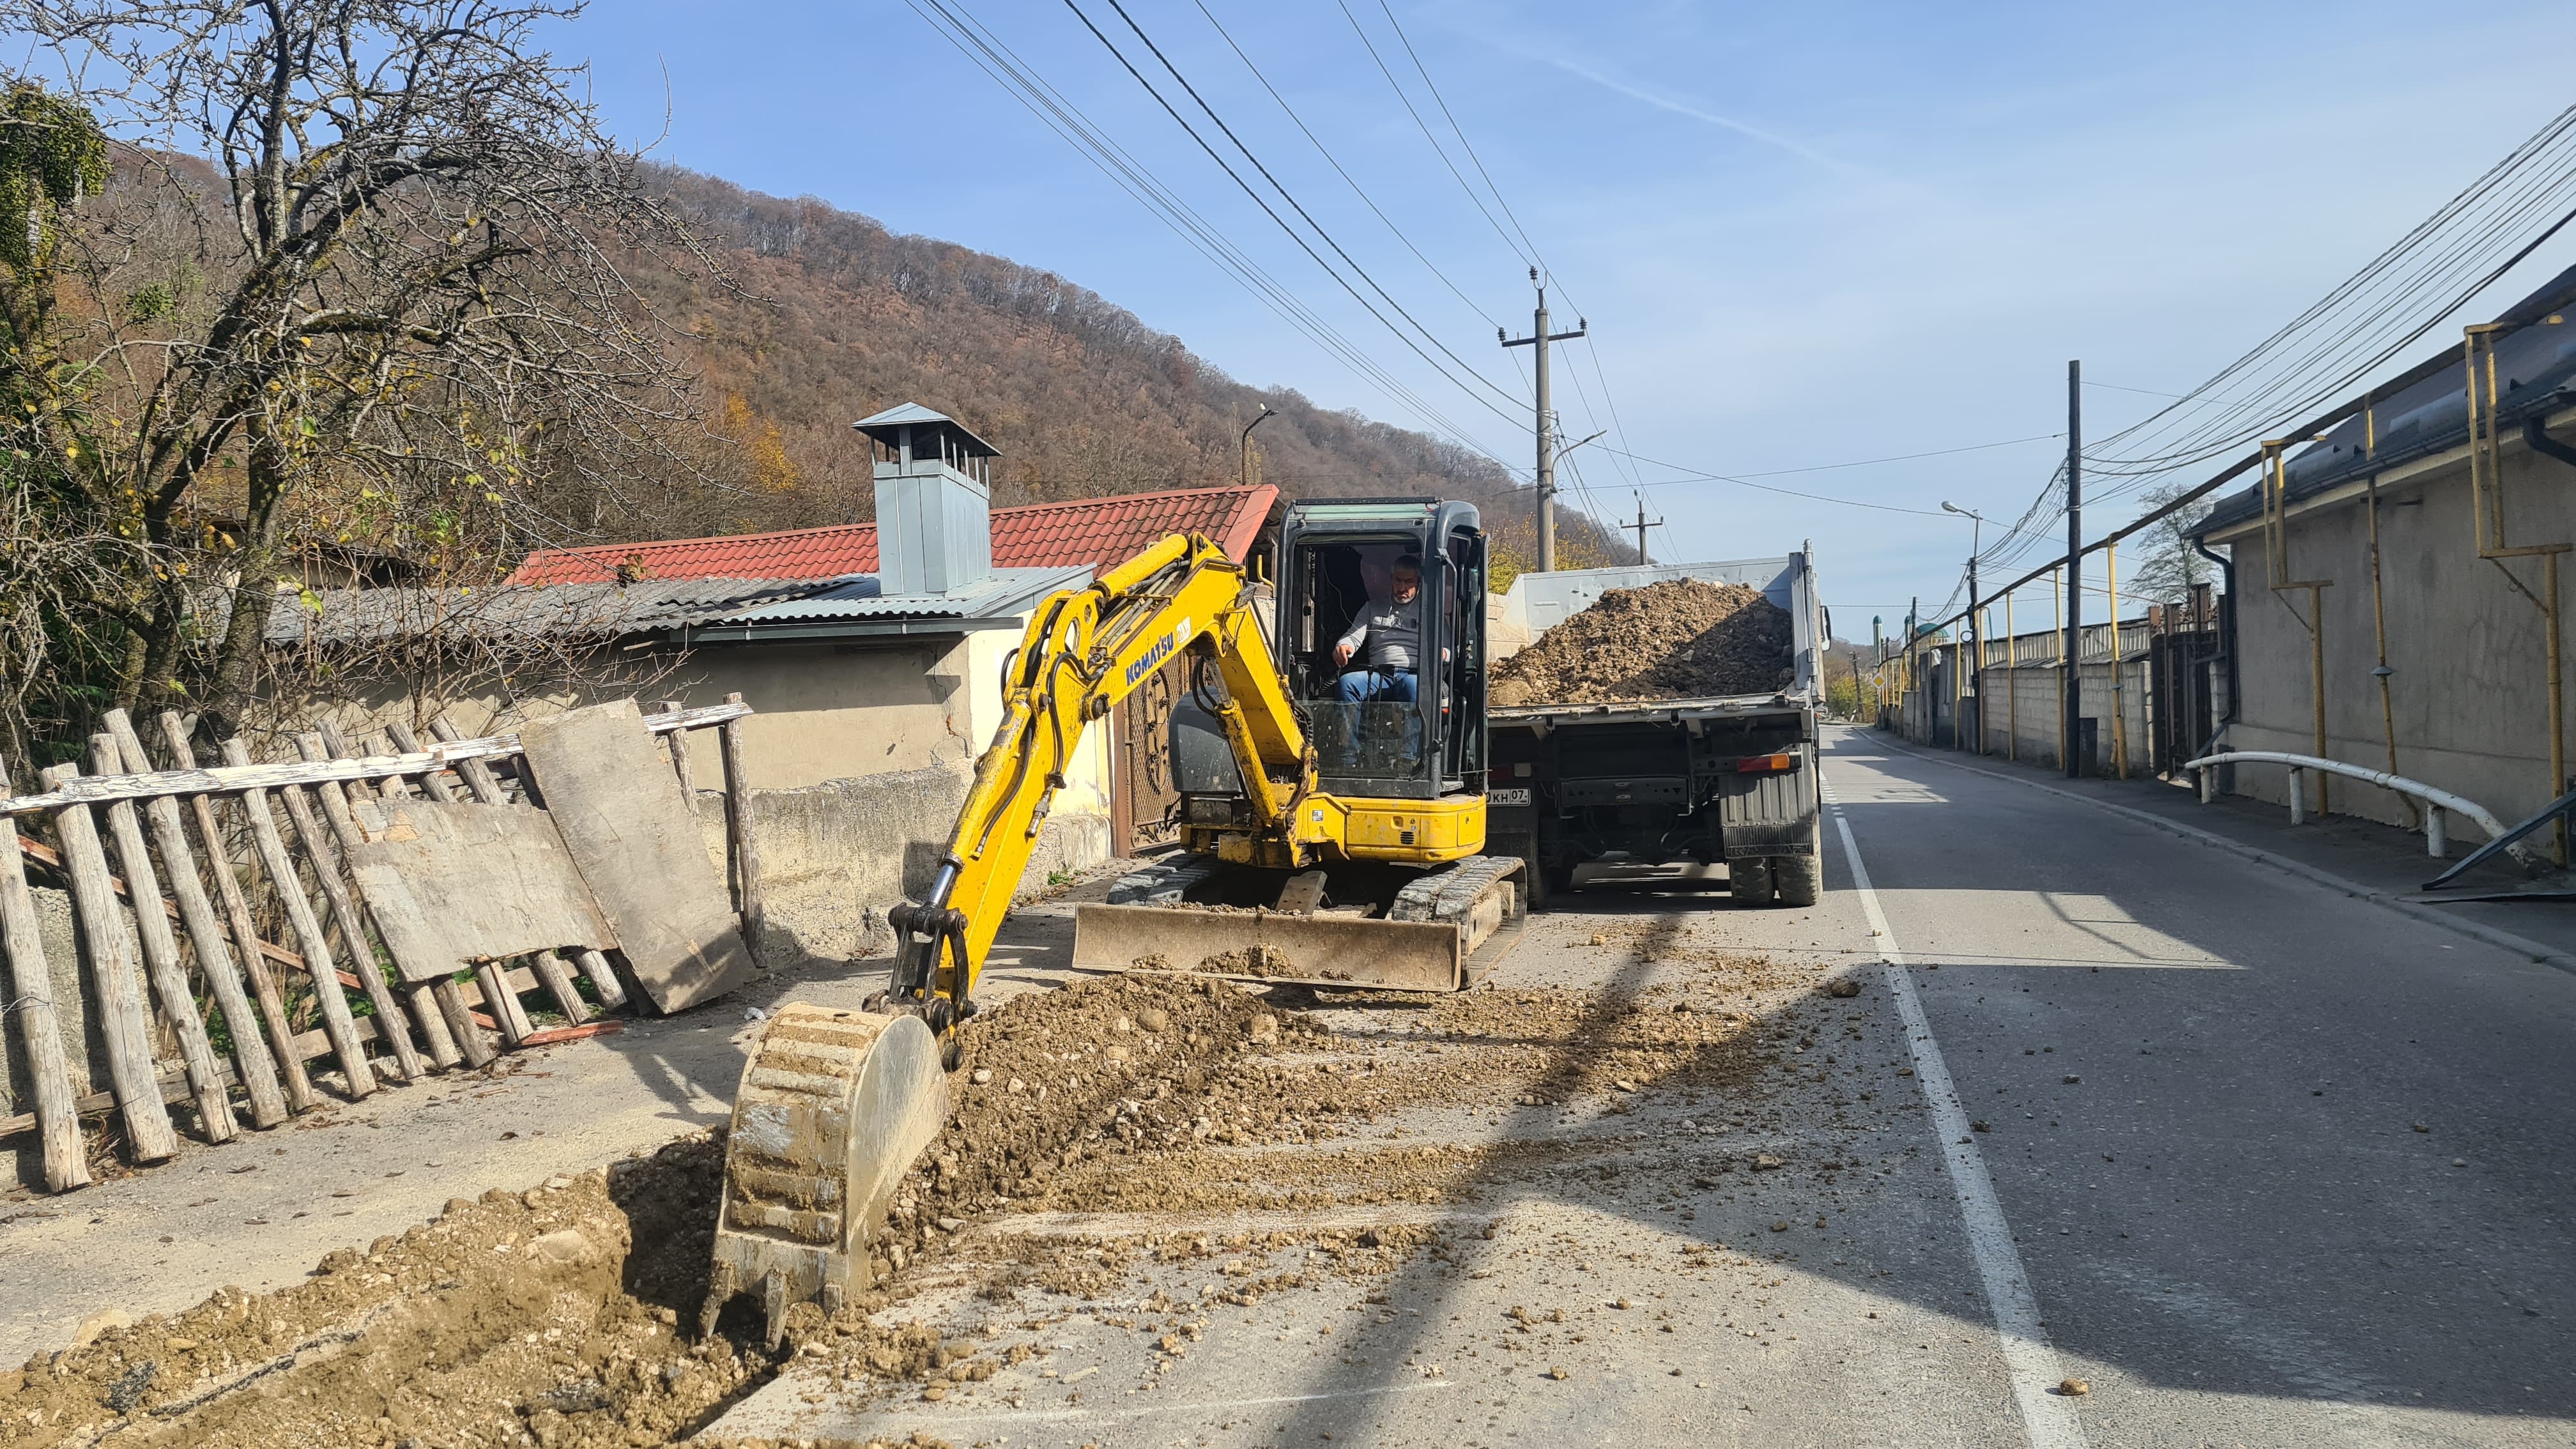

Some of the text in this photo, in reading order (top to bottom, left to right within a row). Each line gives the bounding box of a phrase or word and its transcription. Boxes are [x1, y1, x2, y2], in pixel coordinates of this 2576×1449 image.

[1125, 632, 1174, 687] KOMATSU
[1512, 790, 1524, 799] 07
[1727, 844, 1809, 856] KAAZ
